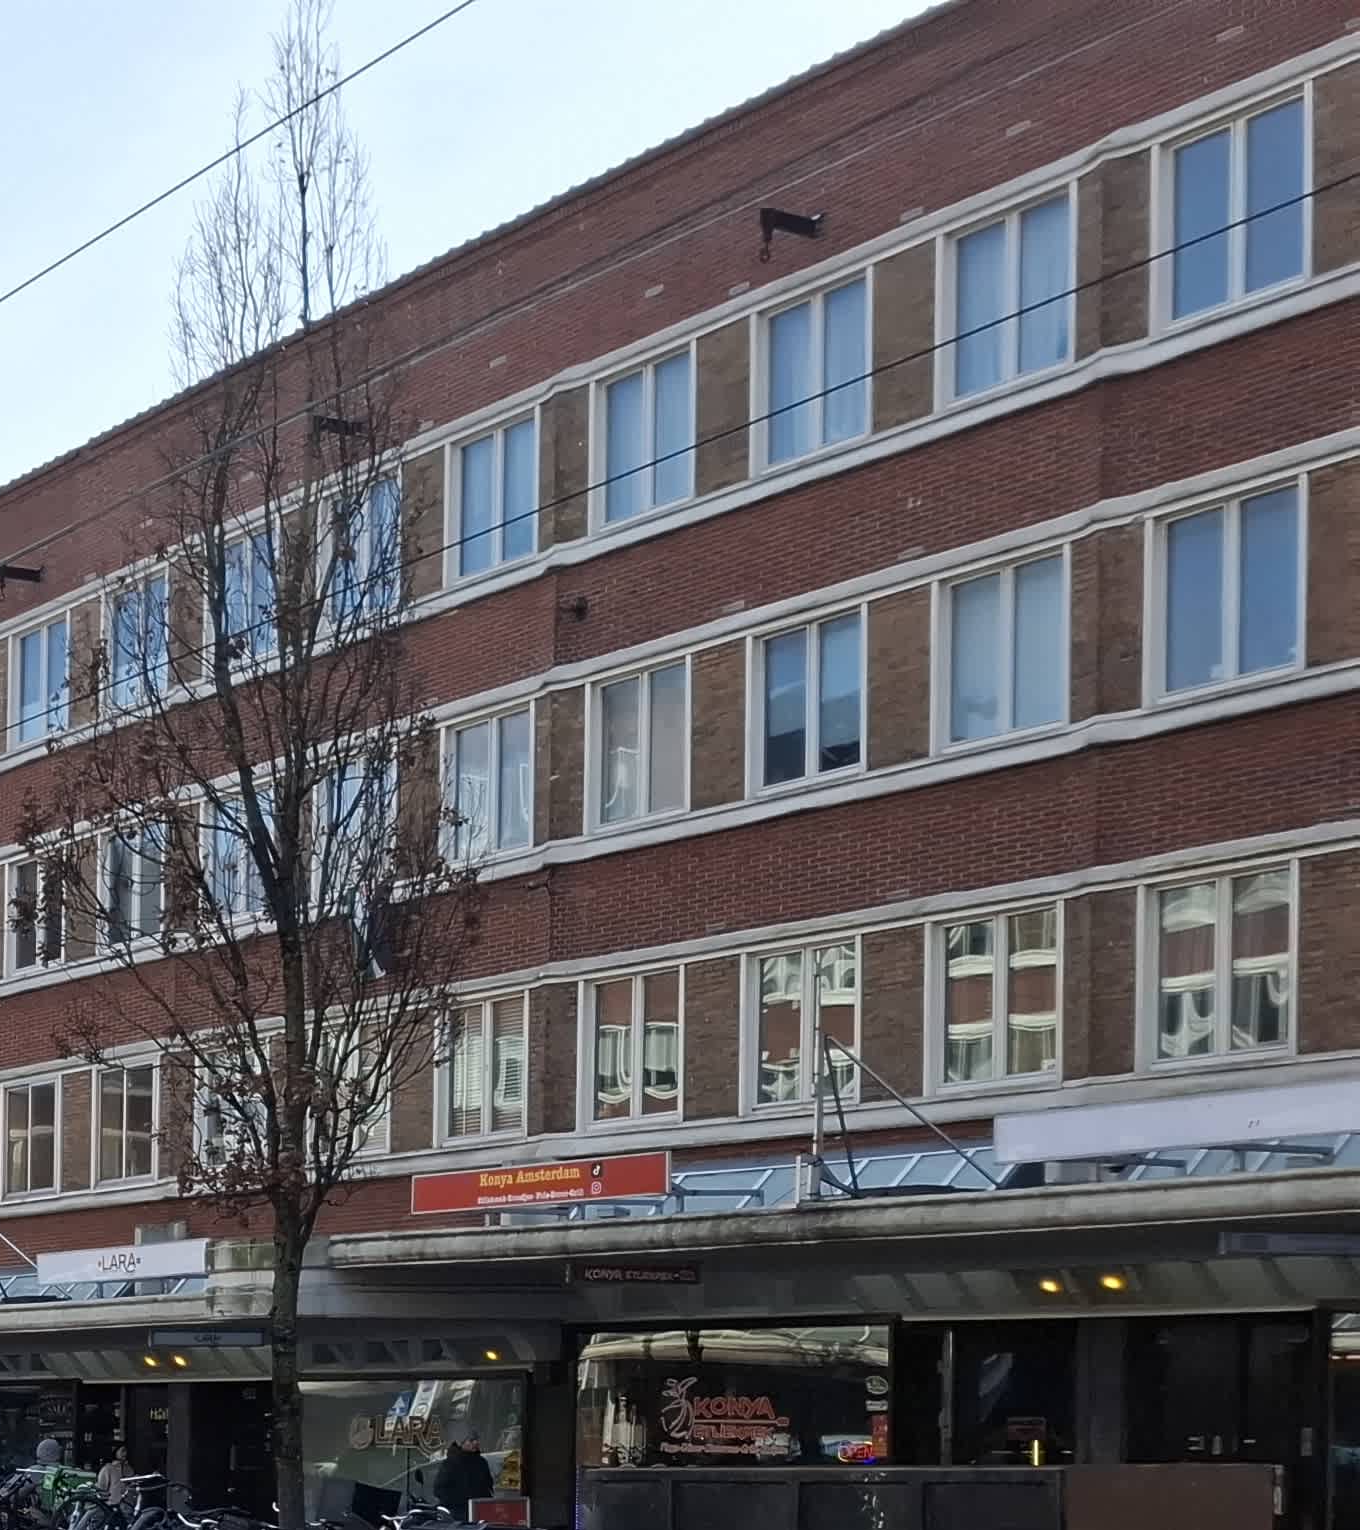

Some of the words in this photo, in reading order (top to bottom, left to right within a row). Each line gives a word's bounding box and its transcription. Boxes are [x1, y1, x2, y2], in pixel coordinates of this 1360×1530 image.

[480, 1173, 513, 1188] Konya
[516, 1166, 580, 1183] Amsterdam
[101, 1253, 137, 1273] LARA
[693, 1396, 776, 1419] KONYA
[375, 1415, 446, 1453] LARA
